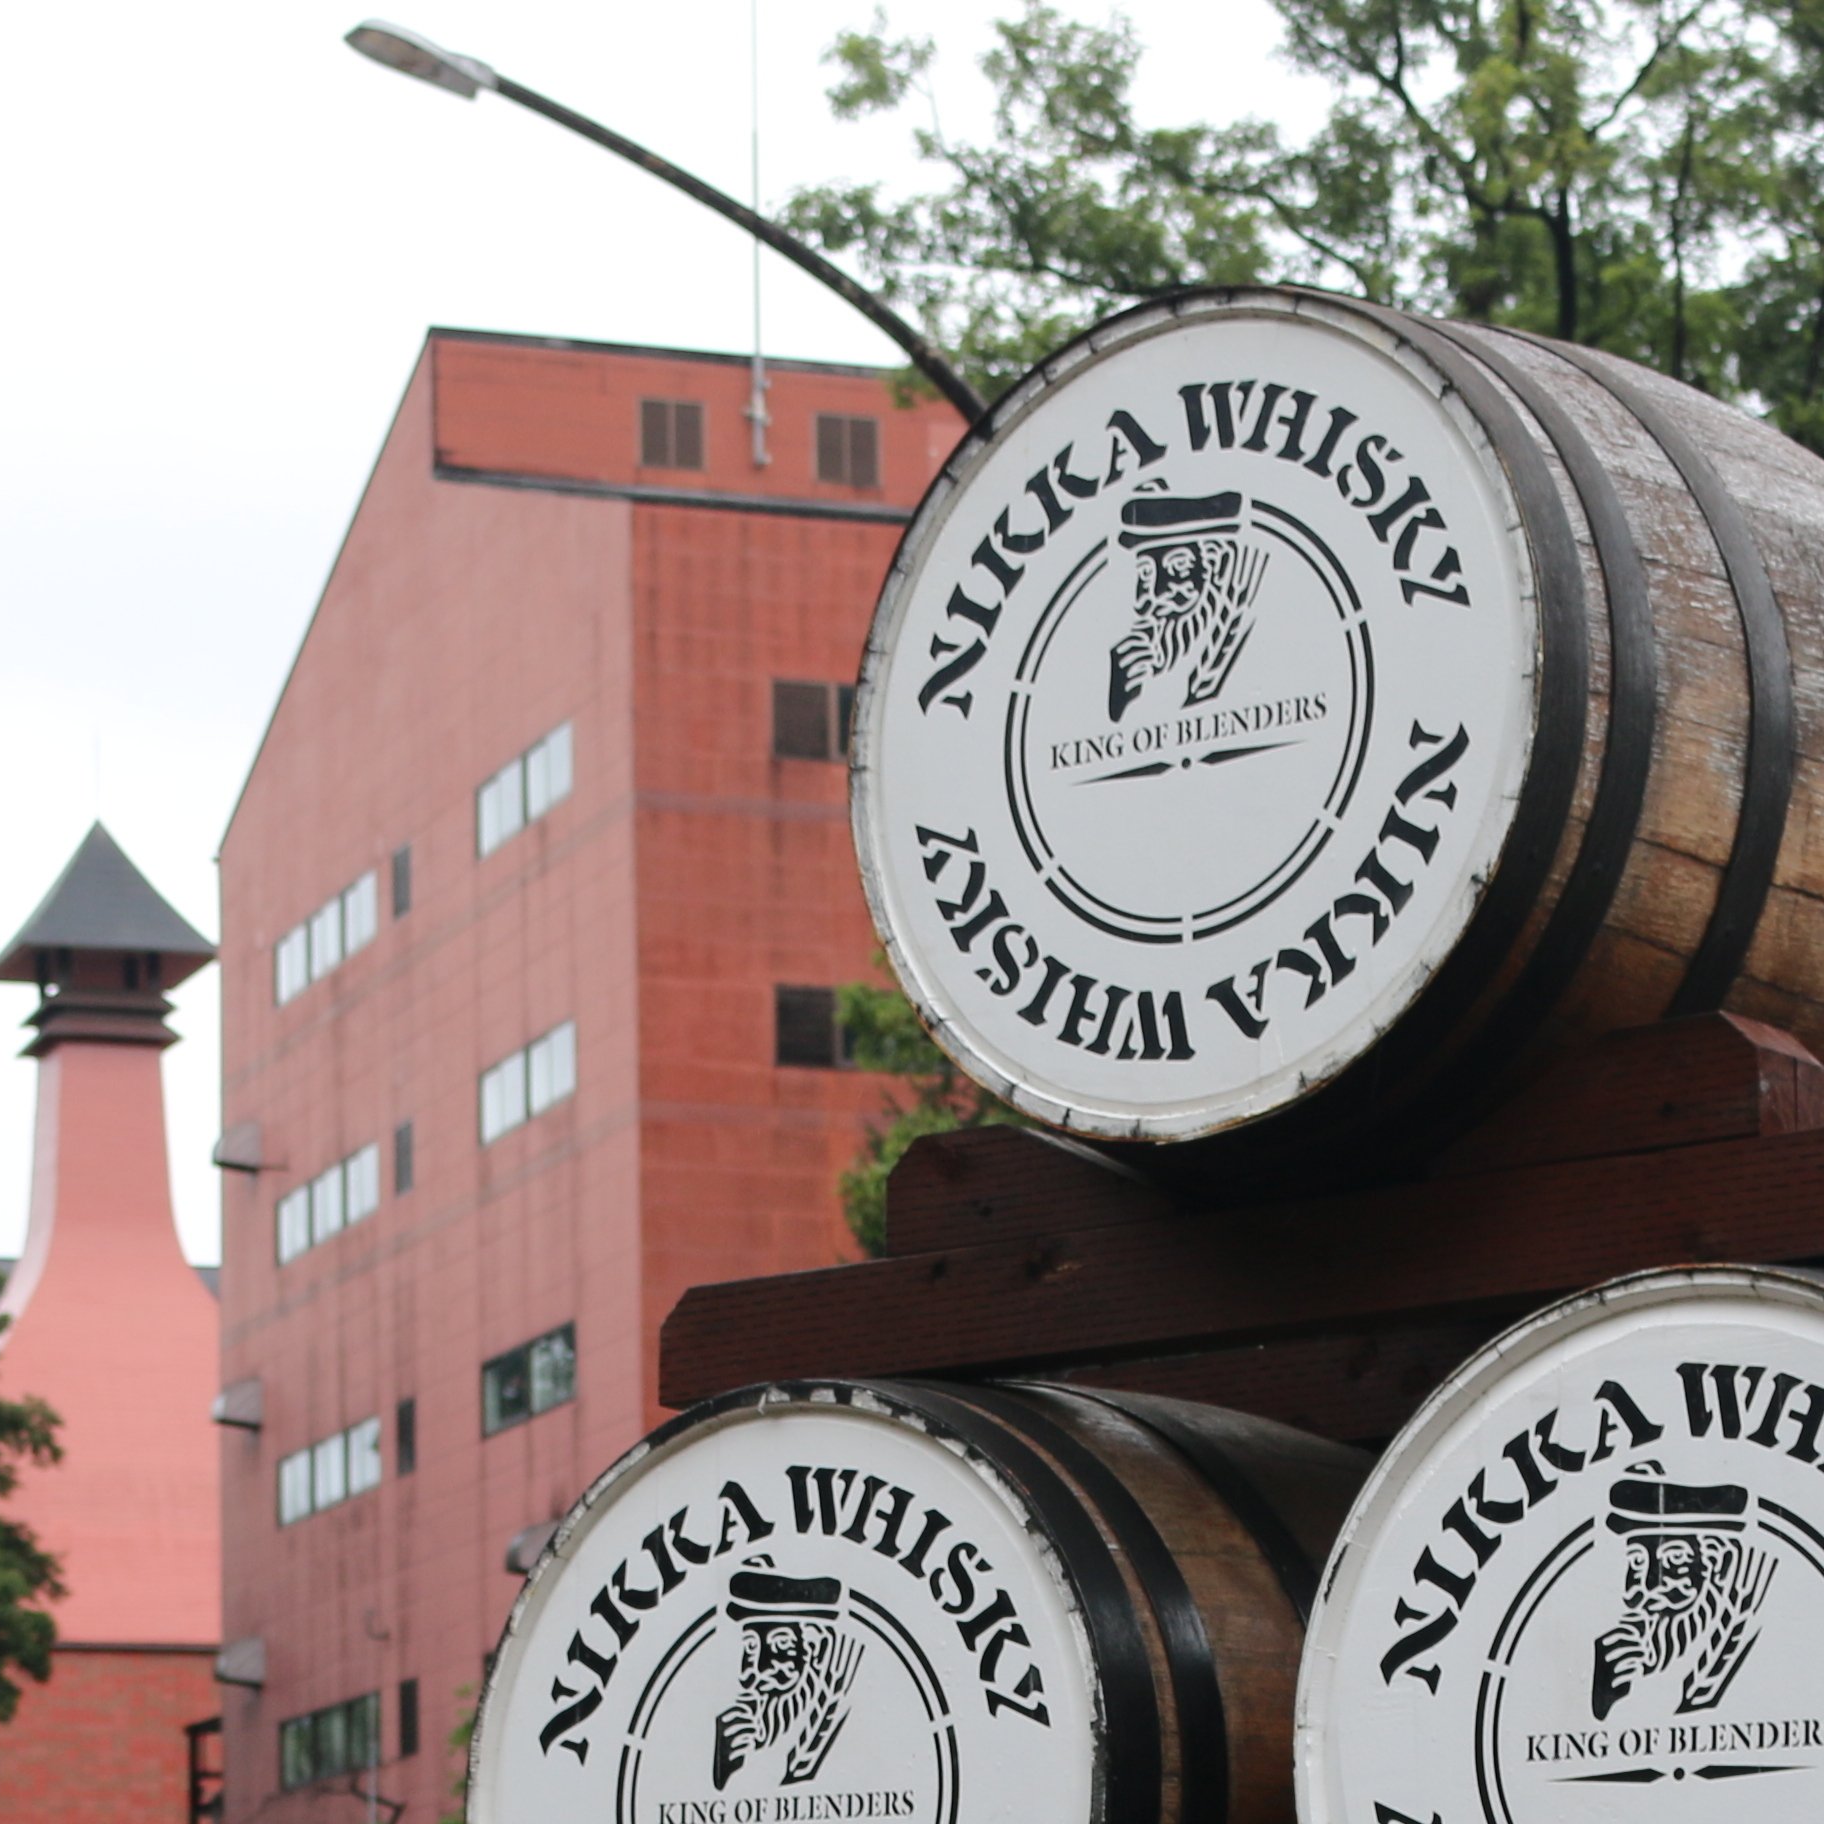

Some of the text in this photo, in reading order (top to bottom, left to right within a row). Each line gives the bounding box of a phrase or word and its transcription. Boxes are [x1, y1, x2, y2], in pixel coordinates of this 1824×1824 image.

[919, 380, 1470, 719] NIKKA WHISKY
[1050, 693, 1328, 771] KING OF BLENDERS
[915, 721, 1469, 1060] NIKKA WHISKY
[539, 1466, 1050, 1765] NIKKA WHISKY
[1380, 1380, 1663, 1695] NIKKA
[734, 1796, 769, 1824] OF
[774, 1790, 915, 1822] BLENDERS
[1526, 1730, 1610, 1762] KING
[1618, 1727, 1661, 1757] OF
